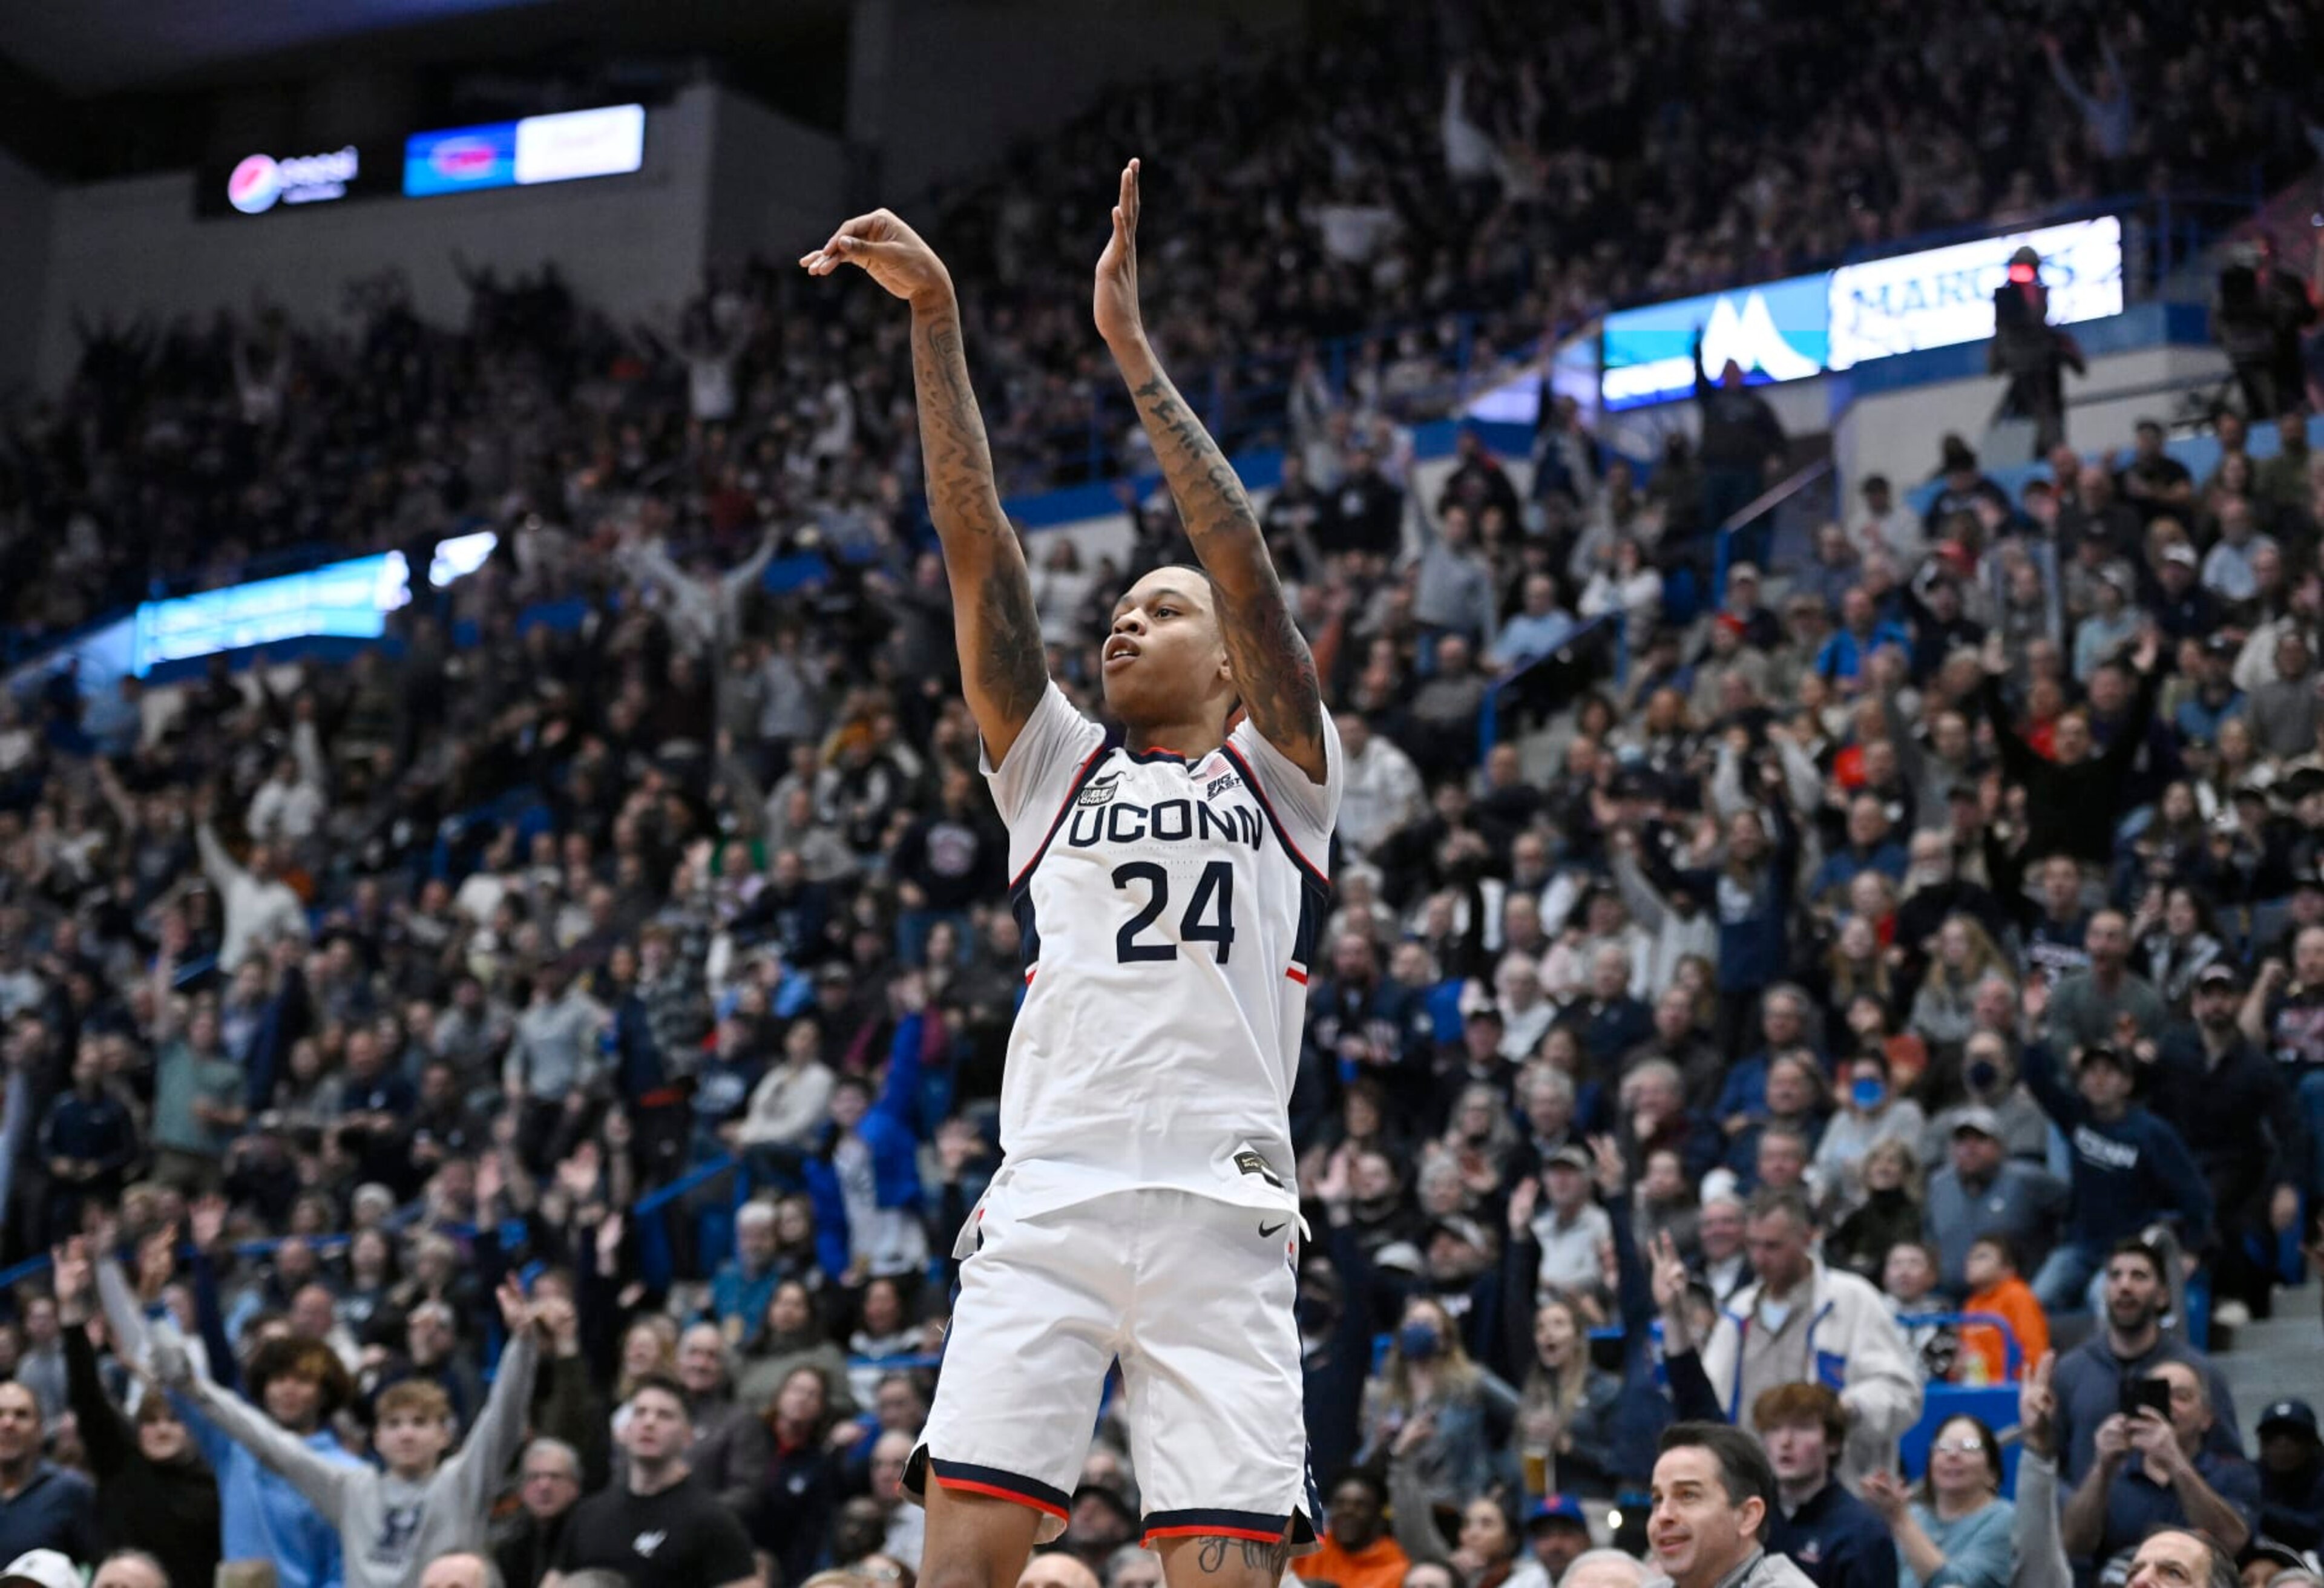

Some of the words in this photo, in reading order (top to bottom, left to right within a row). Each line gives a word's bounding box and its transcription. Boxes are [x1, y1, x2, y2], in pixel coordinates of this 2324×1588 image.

[1851, 252, 2076, 319] MARCS
[1207, 772, 1231, 790] BIG
[1069, 799, 1263, 851] UCONN
[1111, 861, 1235, 964] 24
